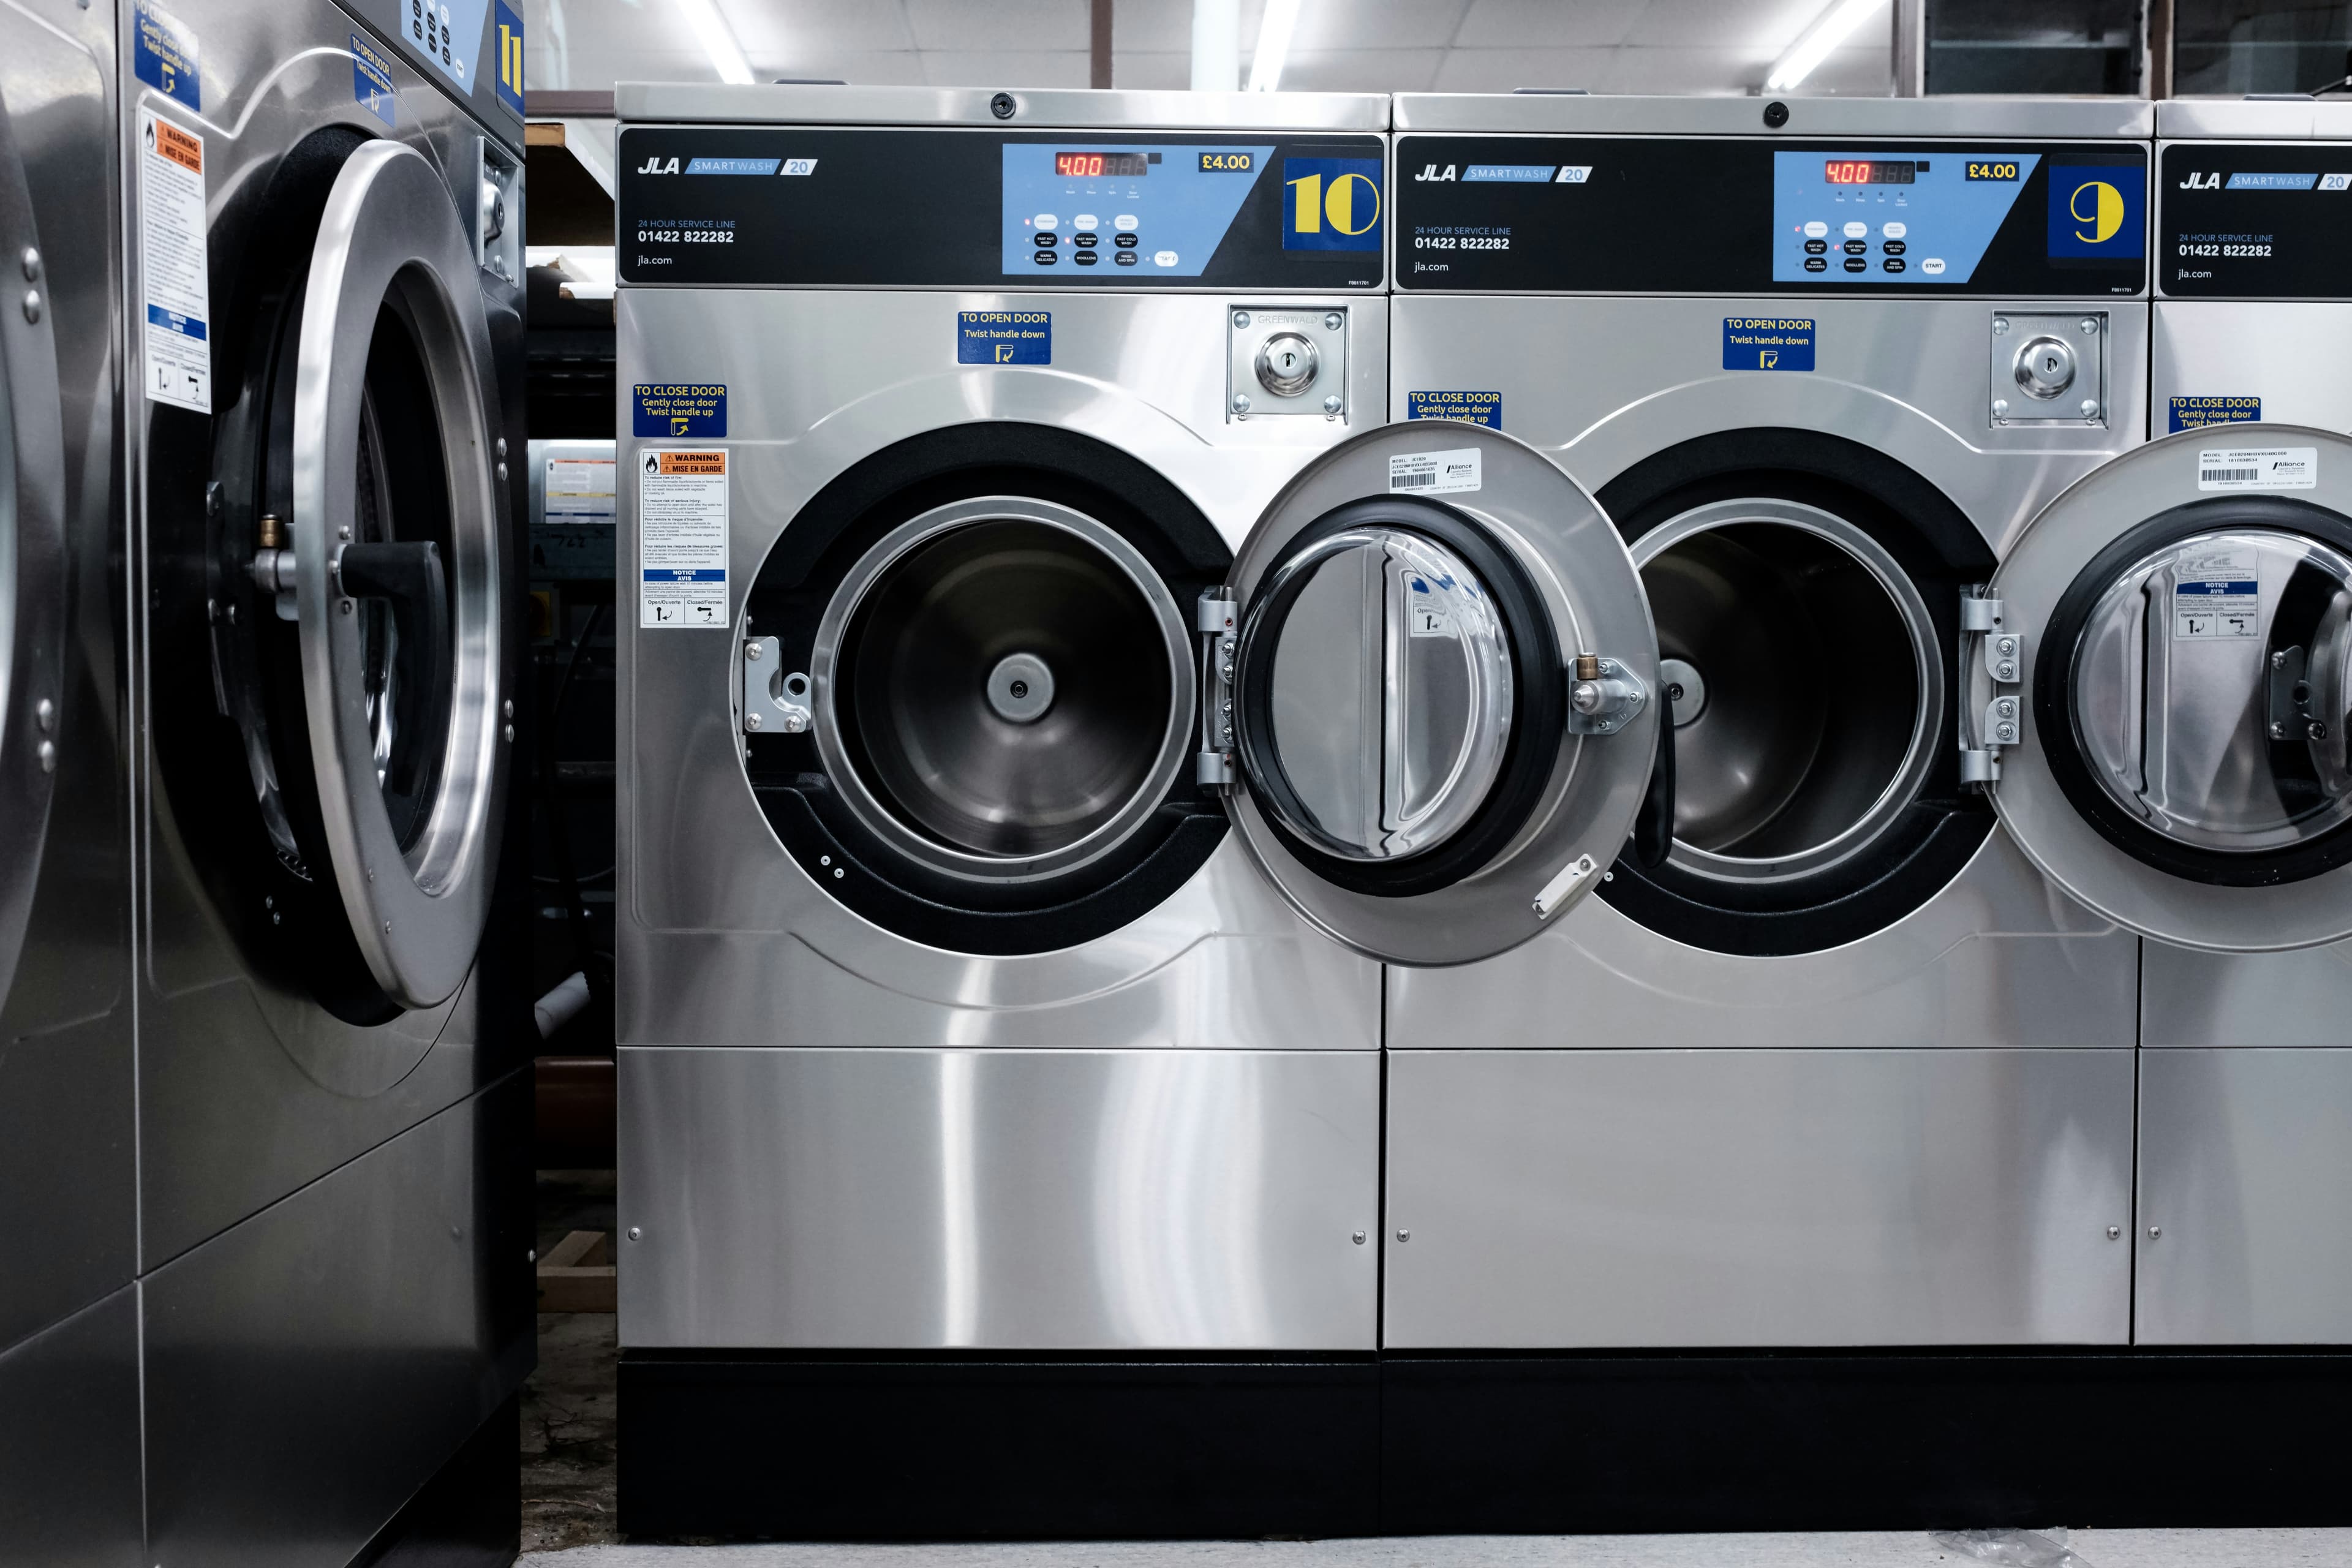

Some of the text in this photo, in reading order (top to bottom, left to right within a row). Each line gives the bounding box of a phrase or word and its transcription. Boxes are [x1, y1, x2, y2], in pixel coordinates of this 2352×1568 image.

[352, 36, 390, 77] TO OPEN DOOR
[499, 24, 521, 98] 11
[356, 60, 368, 75] Twist
[368, 68, 380, 86] handle
[166, 127, 198, 153] WARNING
[165, 144, 200, 170] MISE EN GARDE
[1202, 155, 1250, 170] £4.00
[638, 157, 679, 175] JLA
[790, 161, 808, 173] 20
[1058, 157, 1102, 176] 4.00
[1969, 164, 2016, 178] £4.00
[1415, 164, 1456, 182] JLA
[1565, 169, 1583, 181] 20
[1827, 164, 1869, 183] 4.00
[2179, 172, 2220, 189] JLA
[2327, 176, 2345, 188] 20
[1286, 173, 1380, 235] 10
[2070, 181, 2125, 243] 9
[638, 230, 734, 243] 01422 822282
[1427, 227, 1452, 235] HOUR
[1415, 237, 1510, 250] 01422 822282
[2179, 244, 2272, 257] 01422 822282
[637, 255, 672, 266] jla.com
[1414, 262, 1449, 273] jla.com
[2178, 269, 2212, 280] jla.com
[962, 313, 1048, 323] TO OPEN DOOR
[1258, 315, 1318, 324] GREENWALD
[1727, 319, 1812, 330] TO OPEN DOOR
[990, 330, 1019, 338] handle
[1021, 330, 1045, 338] down
[1755, 336, 1784, 345] handle
[1785, 336, 1809, 345] down
[635, 386, 725, 396] TO CLOSE DOOR
[642, 398, 671, 408] Gently
[697, 398, 717, 407] door
[1410, 393, 1500, 403] TO CLOSE DOOR
[2171, 398, 2259, 408] TO CLOSE DOOR
[671, 407, 701, 416] handle
[1417, 405, 1446, 414] Gently
[1471, 405, 1492, 413] door
[2178, 410, 2252, 420] Gently close door
